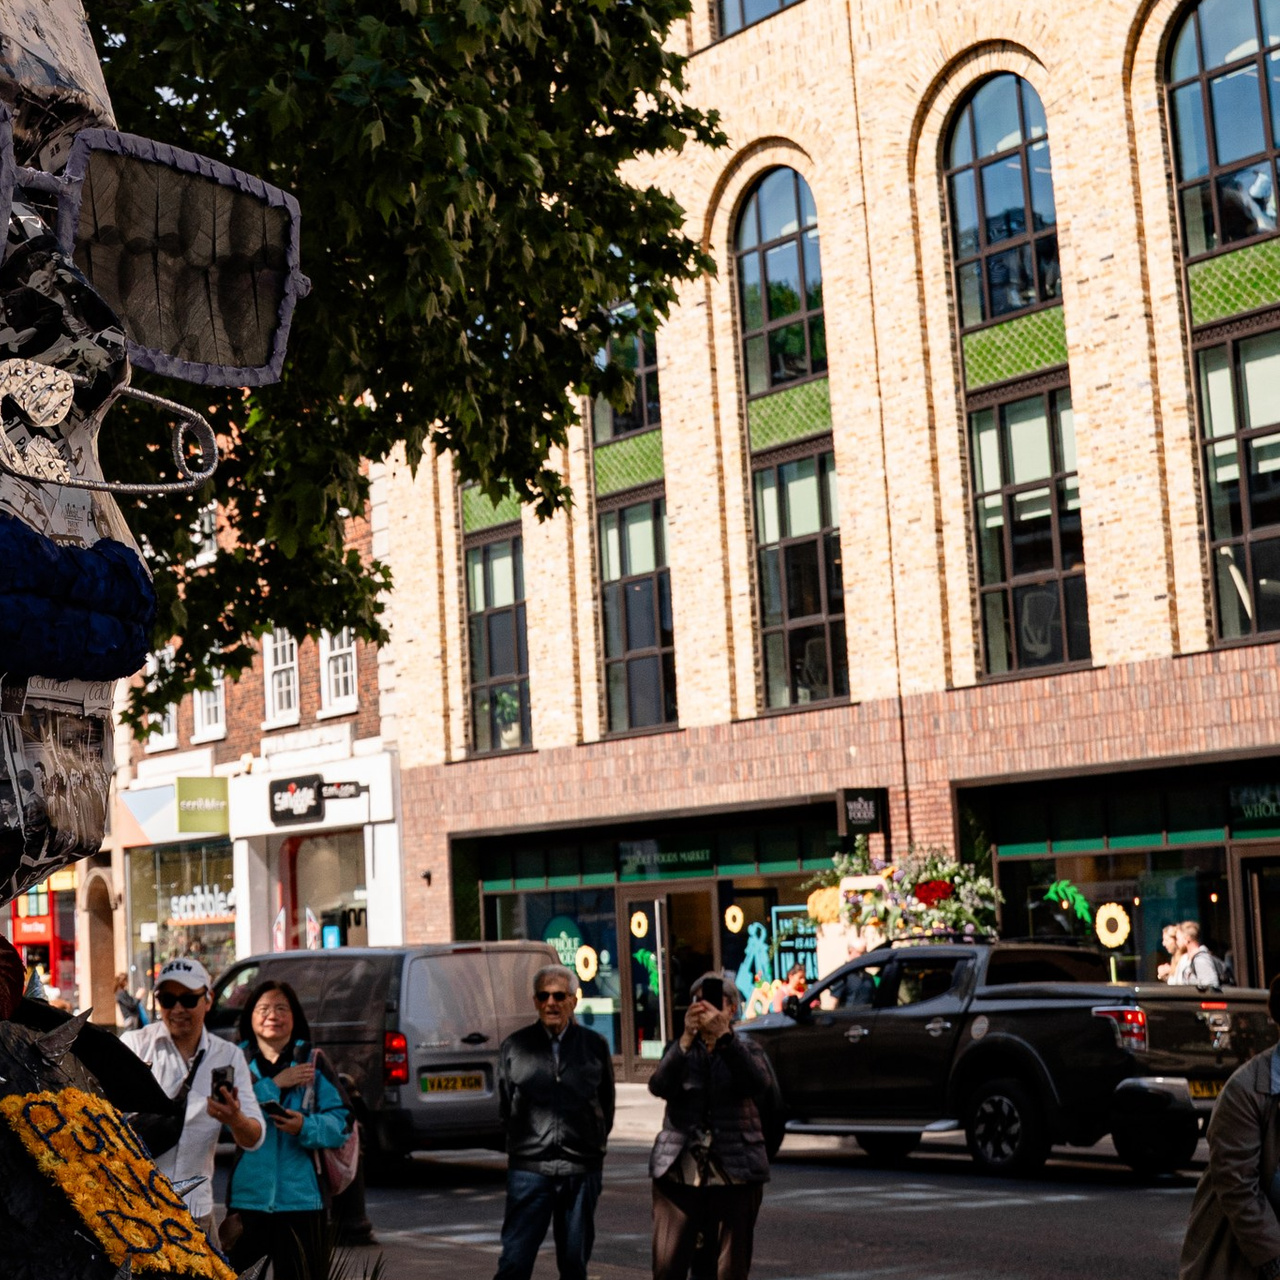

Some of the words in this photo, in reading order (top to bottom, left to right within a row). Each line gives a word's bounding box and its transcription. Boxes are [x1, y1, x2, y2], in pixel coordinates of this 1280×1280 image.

[846, 800, 875, 813] WHOLE
[1241, 801, 1280, 820] WHOL
[679, 848, 712, 863] MARKET
[426, 1075, 458, 1092] VA22
